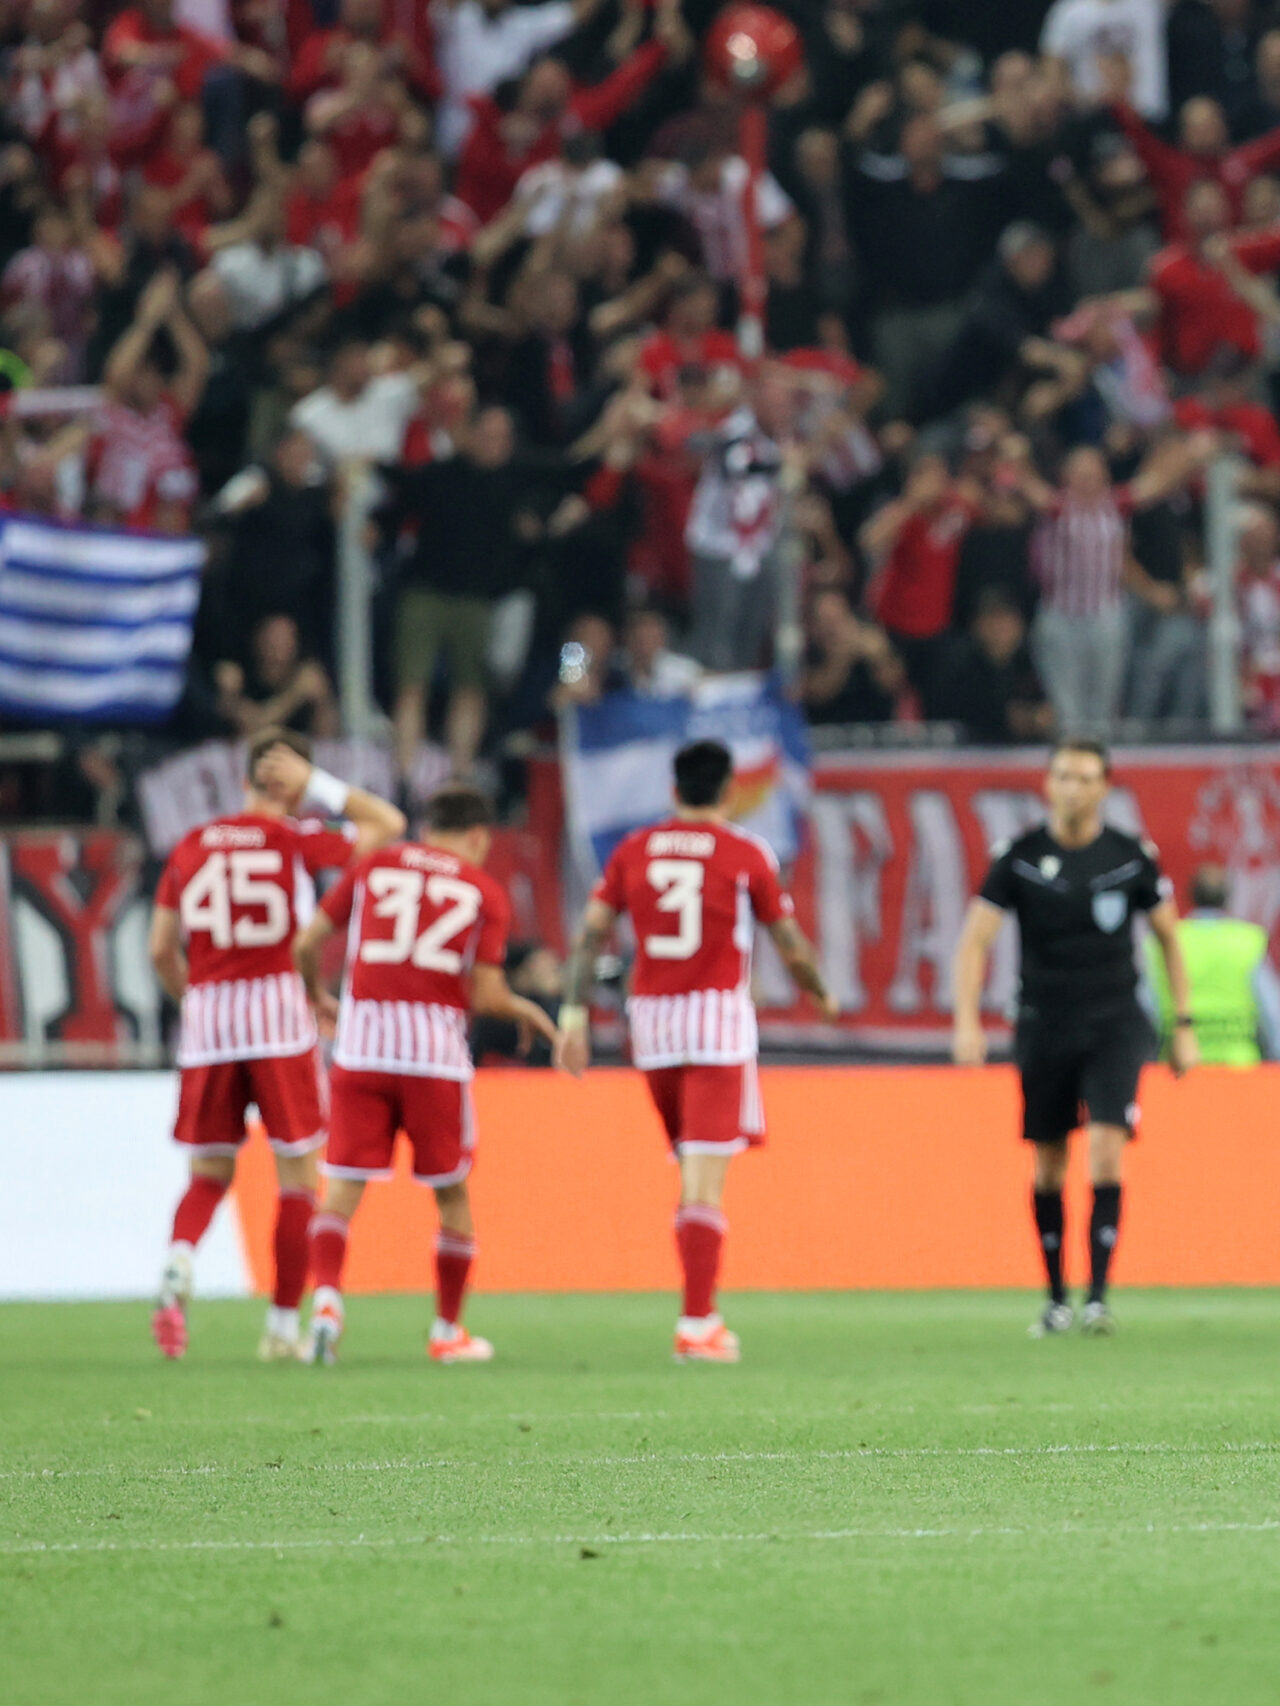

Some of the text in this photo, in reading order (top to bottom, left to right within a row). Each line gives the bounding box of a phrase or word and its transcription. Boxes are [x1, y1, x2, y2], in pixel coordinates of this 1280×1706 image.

[180, 850, 291, 950] 45
[360, 866, 483, 975] 32
[644, 857, 705, 960] 3
